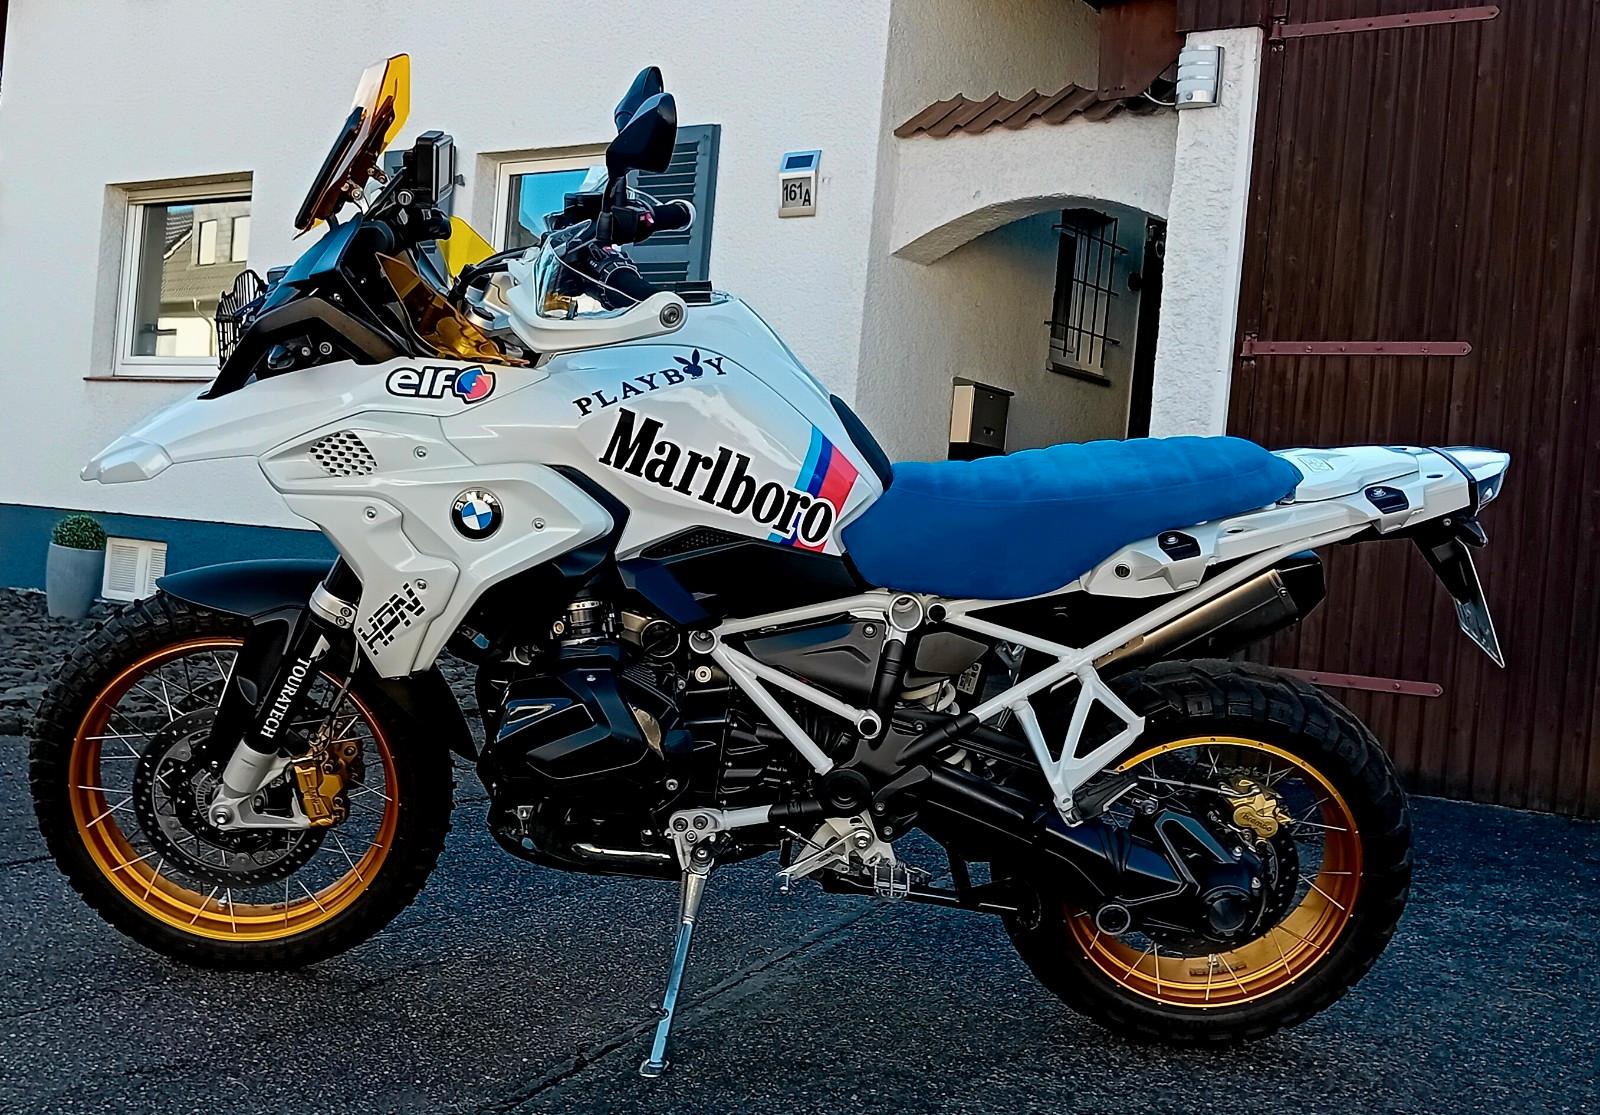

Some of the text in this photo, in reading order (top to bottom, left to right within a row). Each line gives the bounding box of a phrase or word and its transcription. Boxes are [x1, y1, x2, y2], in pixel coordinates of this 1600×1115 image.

[783, 182, 812, 207] 161A
[386, 366, 459, 398] elf
[572, 348, 727, 417] PLAYBY
[598, 407, 834, 543] Marlboro
[454, 491, 495, 512] BMW
[260, 658, 312, 739] TOURATECH
